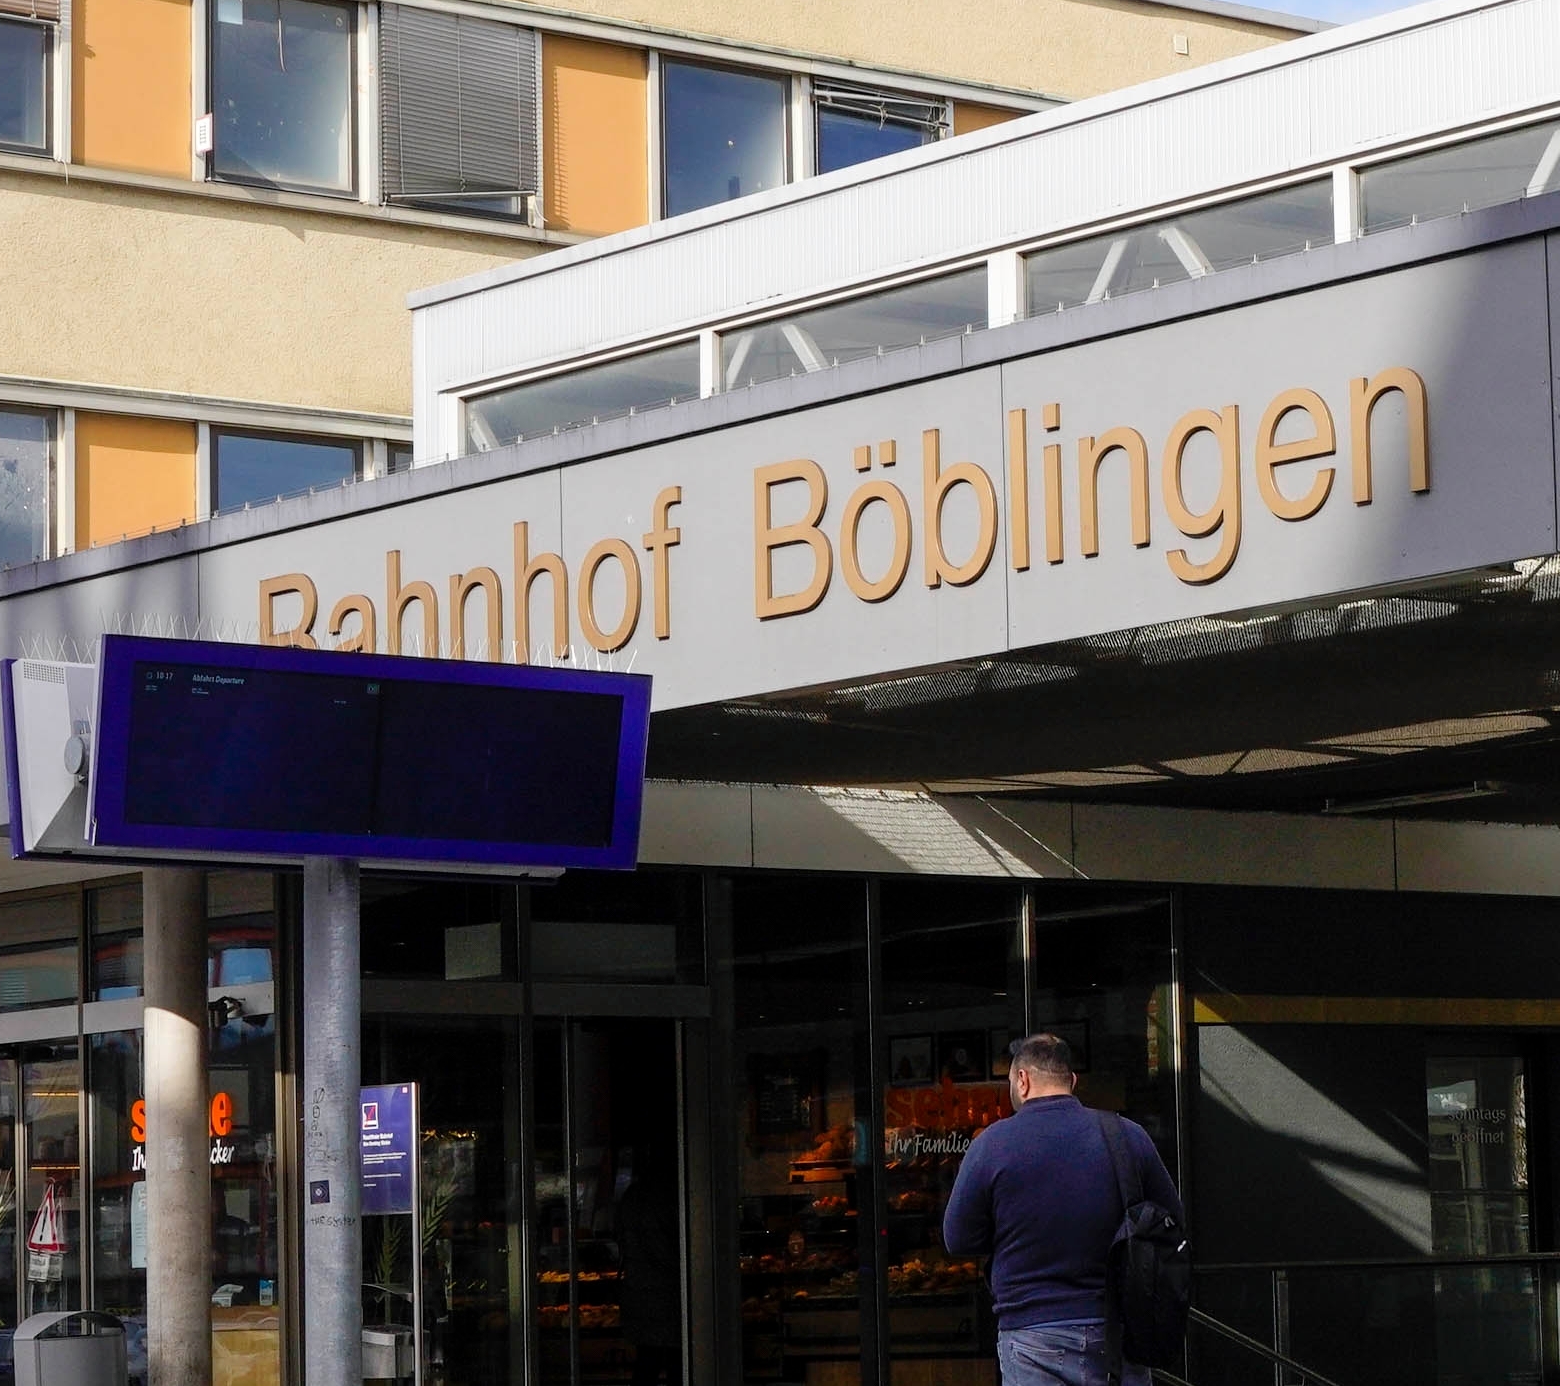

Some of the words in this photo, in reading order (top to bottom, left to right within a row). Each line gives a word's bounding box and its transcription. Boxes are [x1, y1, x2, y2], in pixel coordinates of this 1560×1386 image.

[260, 484, 682, 666] Bahnhof
[754, 366, 1431, 620] Böblingen
[886, 1077, 1010, 1127] sehn
[132, 1146, 146, 1171] Ih
[885, 1129, 913, 1155] Ihr
[913, 1130, 973, 1157] Familie
